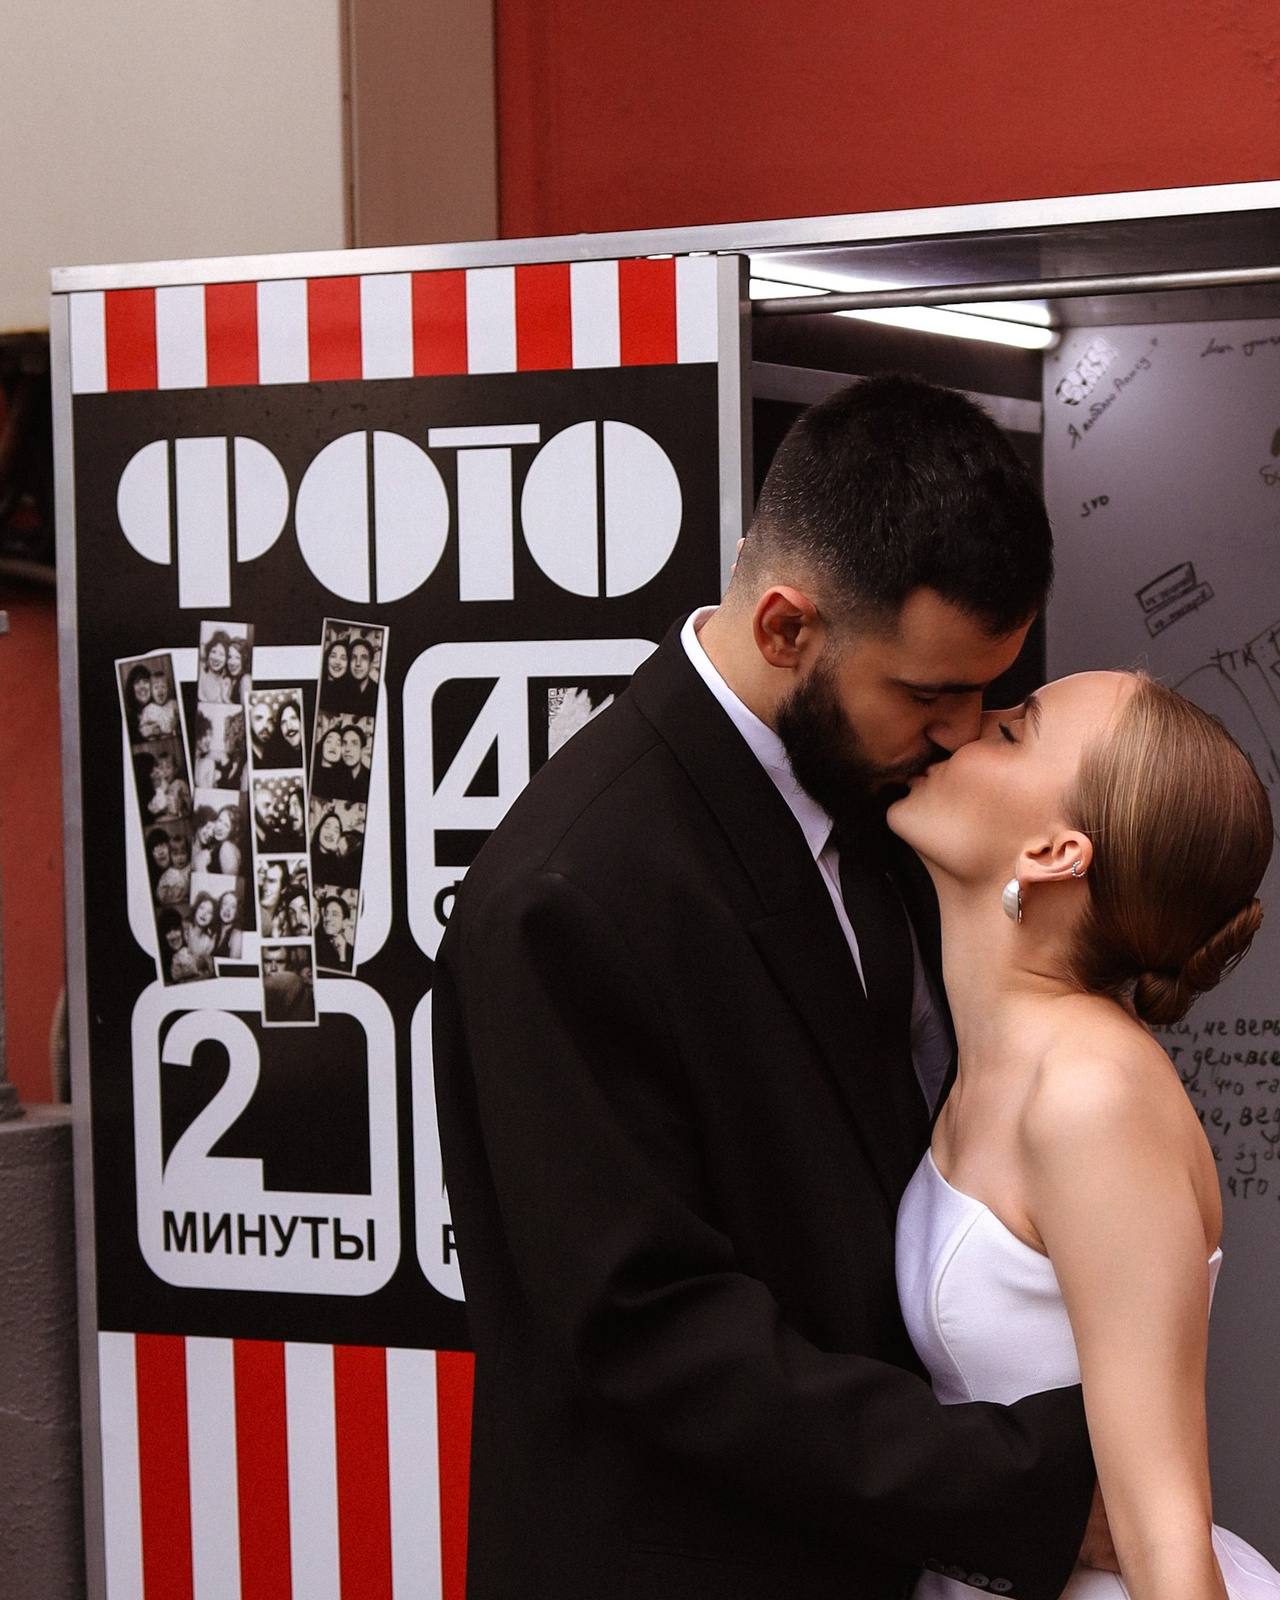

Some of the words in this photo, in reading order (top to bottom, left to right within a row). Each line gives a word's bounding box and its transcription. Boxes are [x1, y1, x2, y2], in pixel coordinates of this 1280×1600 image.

[117, 420, 682, 608] ФОТО
[161, 1008, 264, 1191] 2
[162, 1210, 376, 1262] МИНУТЫ
[1227, 1175, 1270, 1199] что
